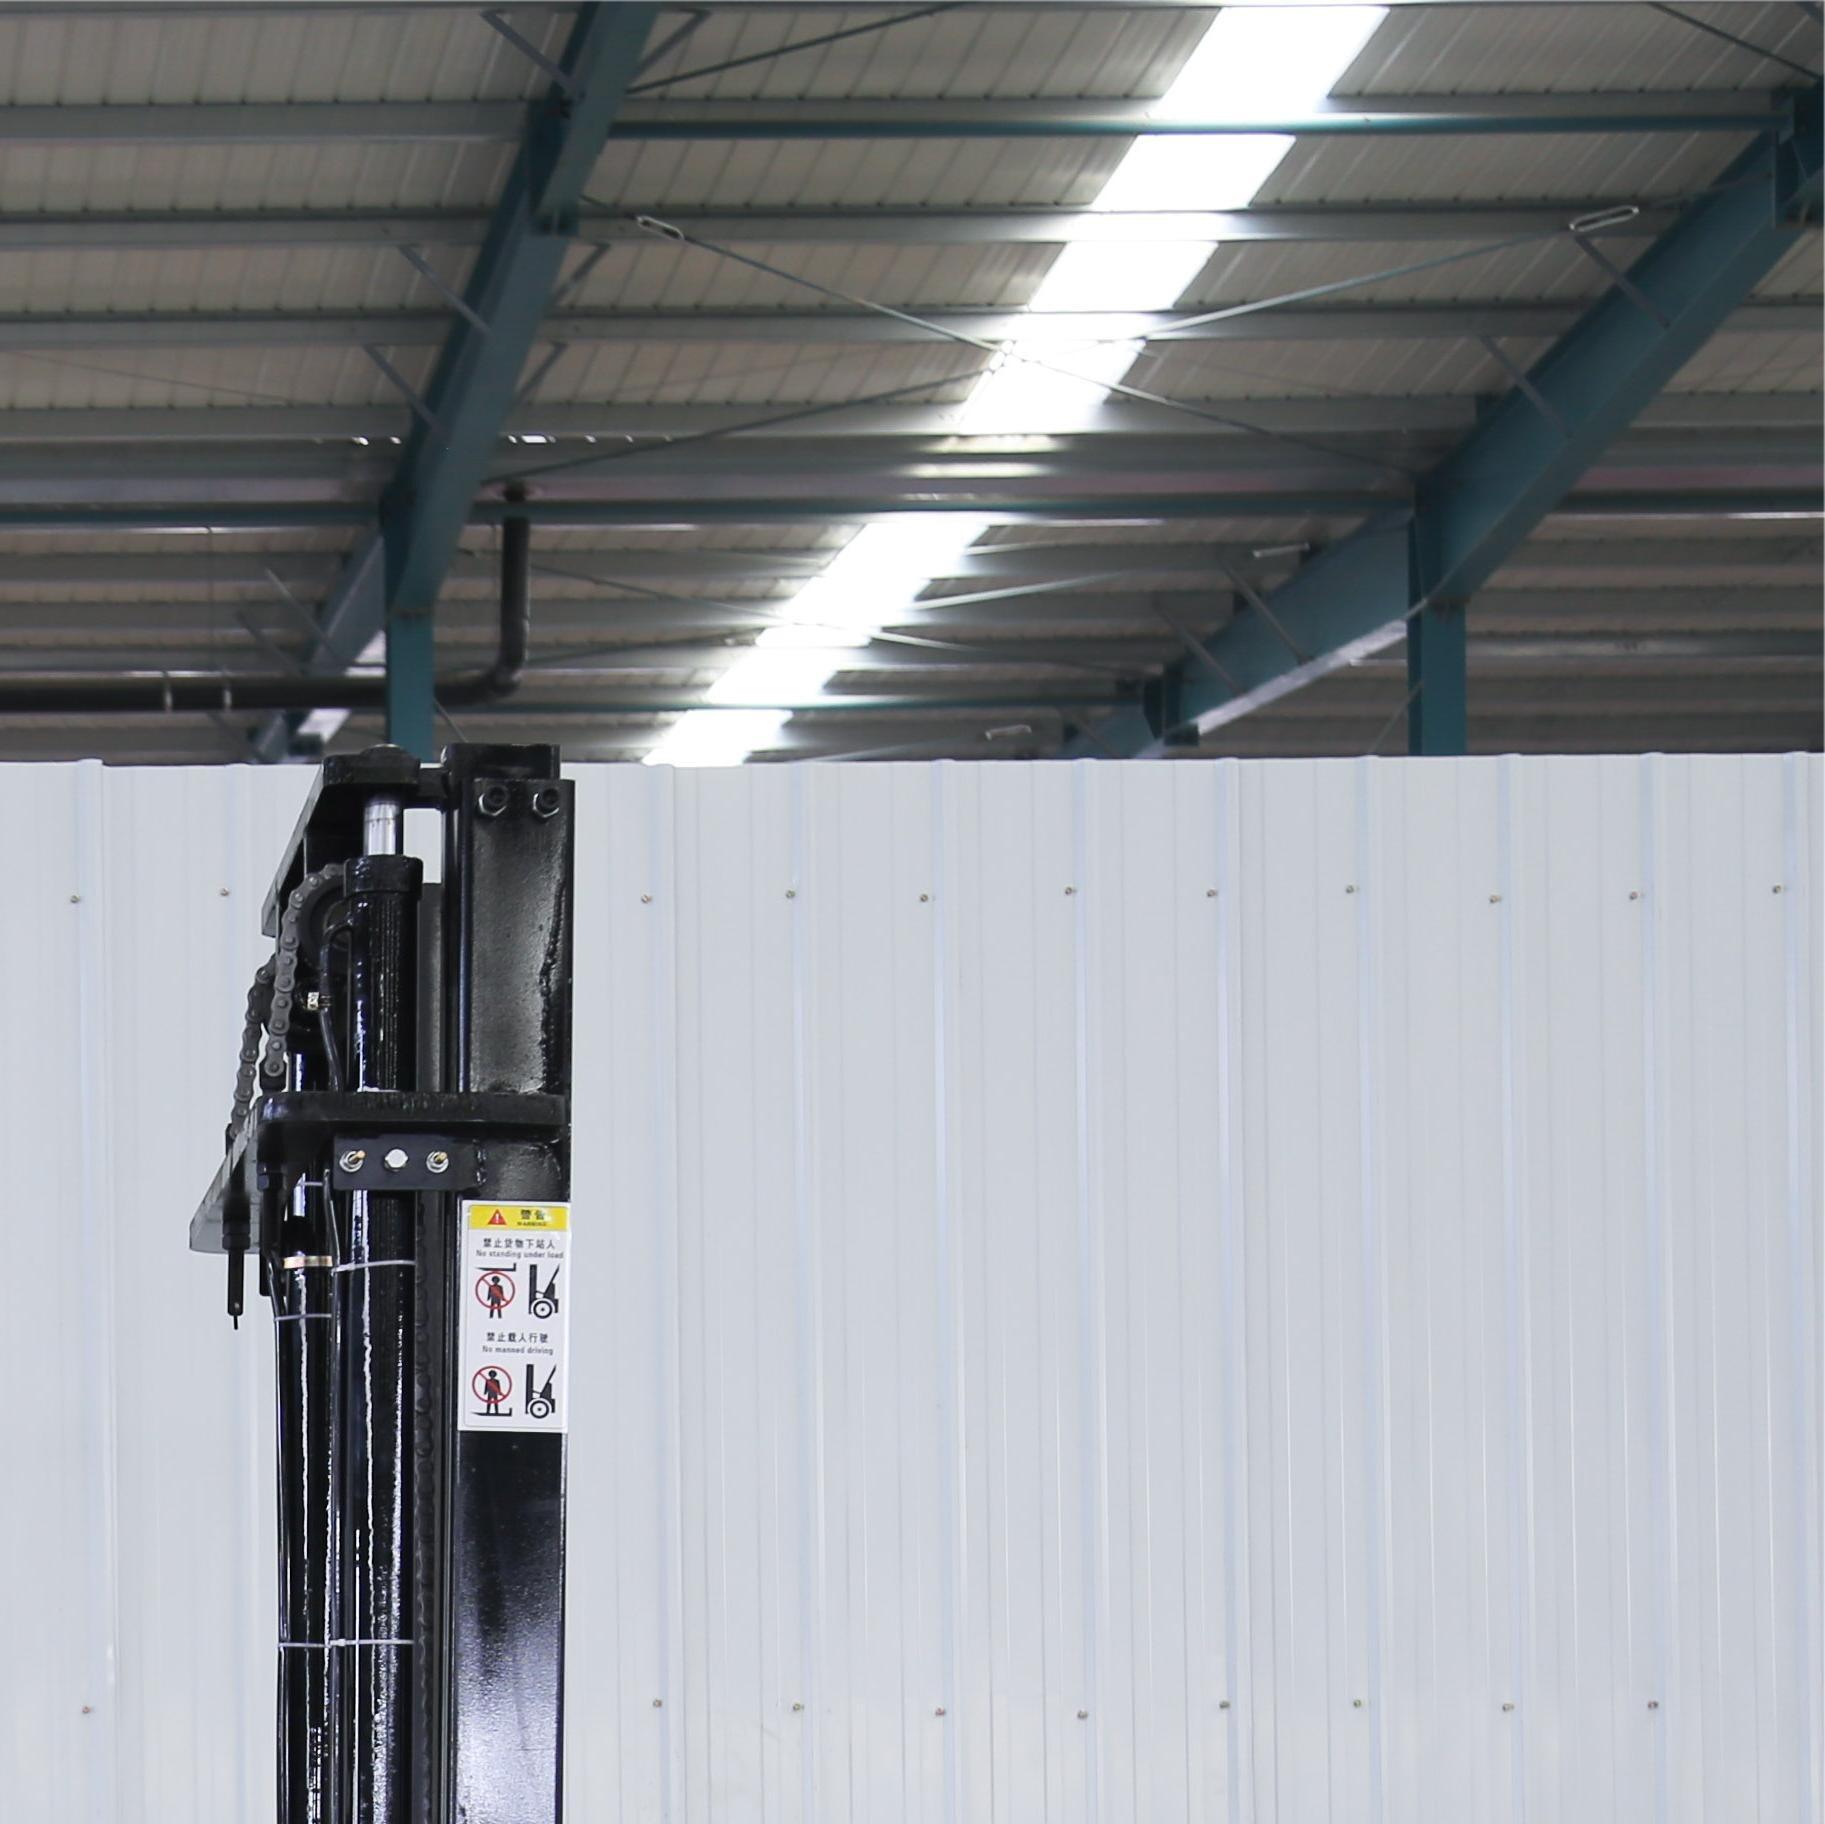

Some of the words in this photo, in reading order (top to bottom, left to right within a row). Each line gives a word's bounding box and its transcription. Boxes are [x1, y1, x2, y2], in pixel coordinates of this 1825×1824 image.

[476, 1249, 487, 1257] No
[489, 1250, 522, 1259] standing
[547, 1251, 564, 1259] load
[482, 1345, 493, 1353] No
[495, 1346, 525, 1354] manned
[527, 1347, 554, 1356] driving
